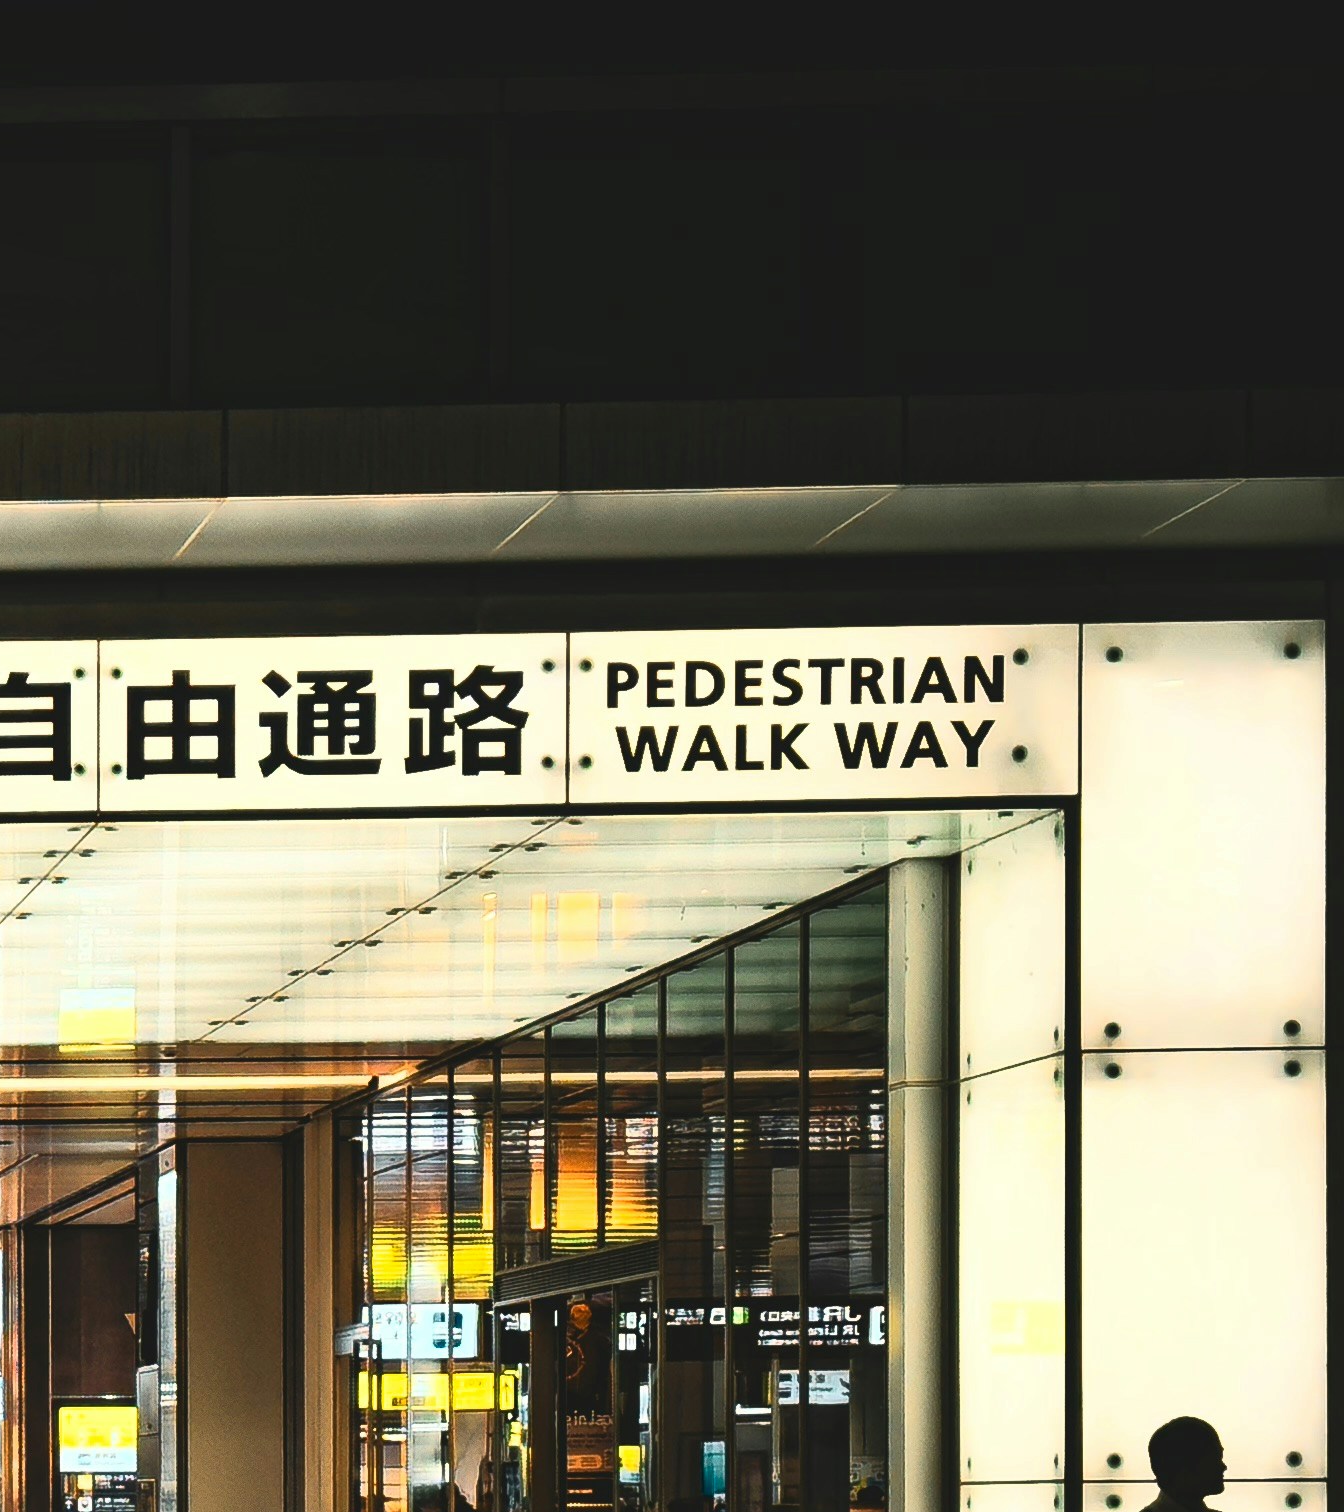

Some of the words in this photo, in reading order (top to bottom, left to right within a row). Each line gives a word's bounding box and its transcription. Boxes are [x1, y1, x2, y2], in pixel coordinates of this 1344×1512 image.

[607, 654, 1004, 709] PEDESTRIAN
[616, 722, 809, 773] WALK
[834, 719, 995, 770] WAY
